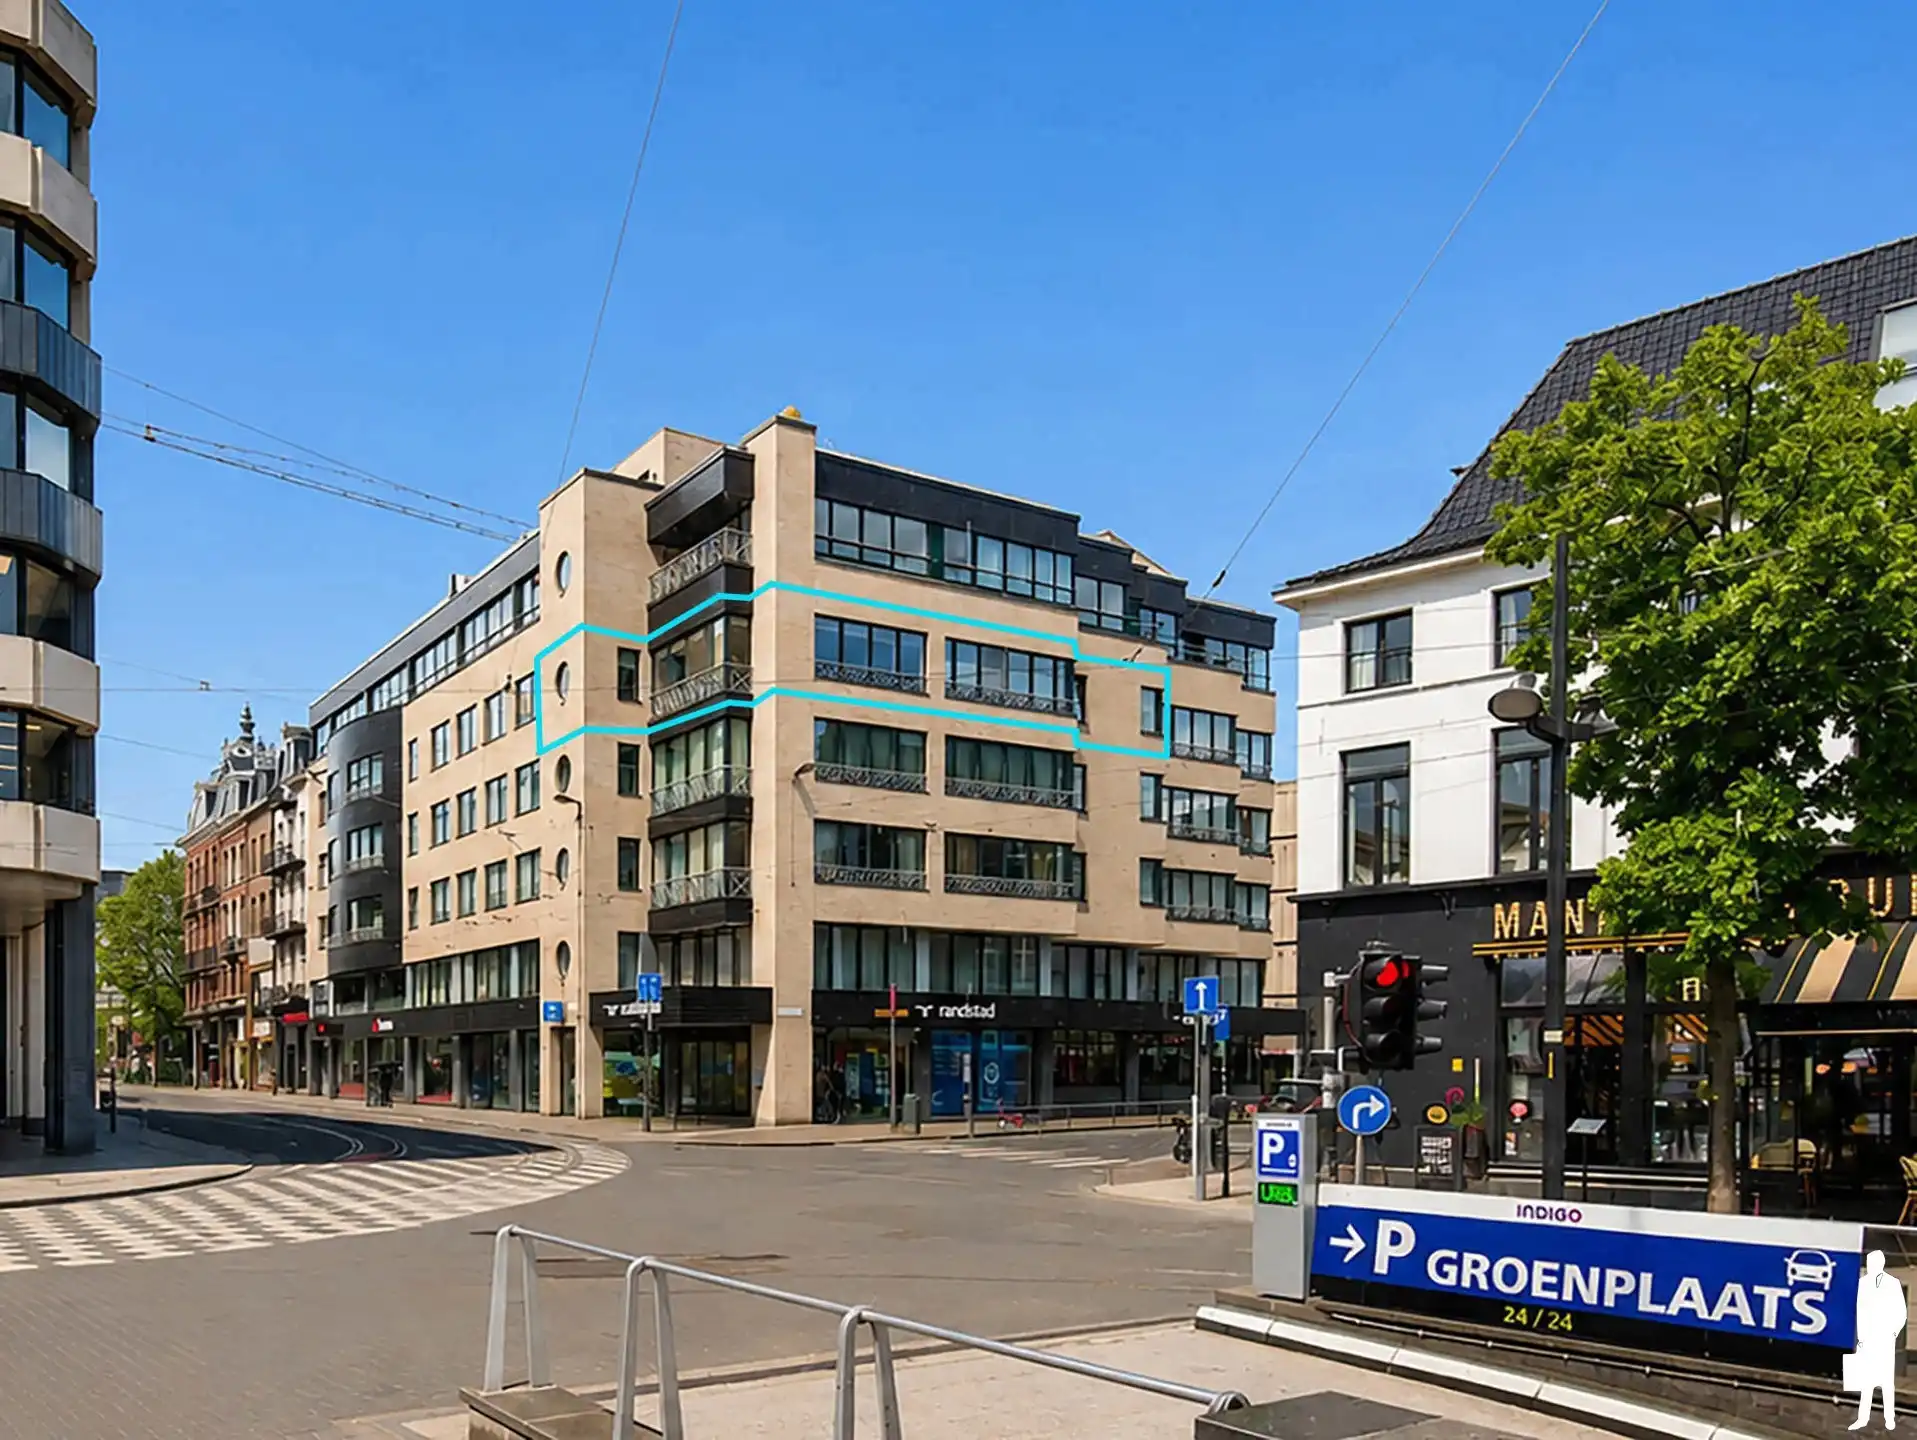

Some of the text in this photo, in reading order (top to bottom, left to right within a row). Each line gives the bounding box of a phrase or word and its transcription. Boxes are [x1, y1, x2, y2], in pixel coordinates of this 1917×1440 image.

[1262, 1131, 1285, 1166] P
[1516, 1203, 1582, 1223] INDIGO
[1373, 1218, 1828, 1335] P GROENPLAATS
[1503, 1305, 1527, 1325] 24
[1547, 1311, 1573, 1331] 24
